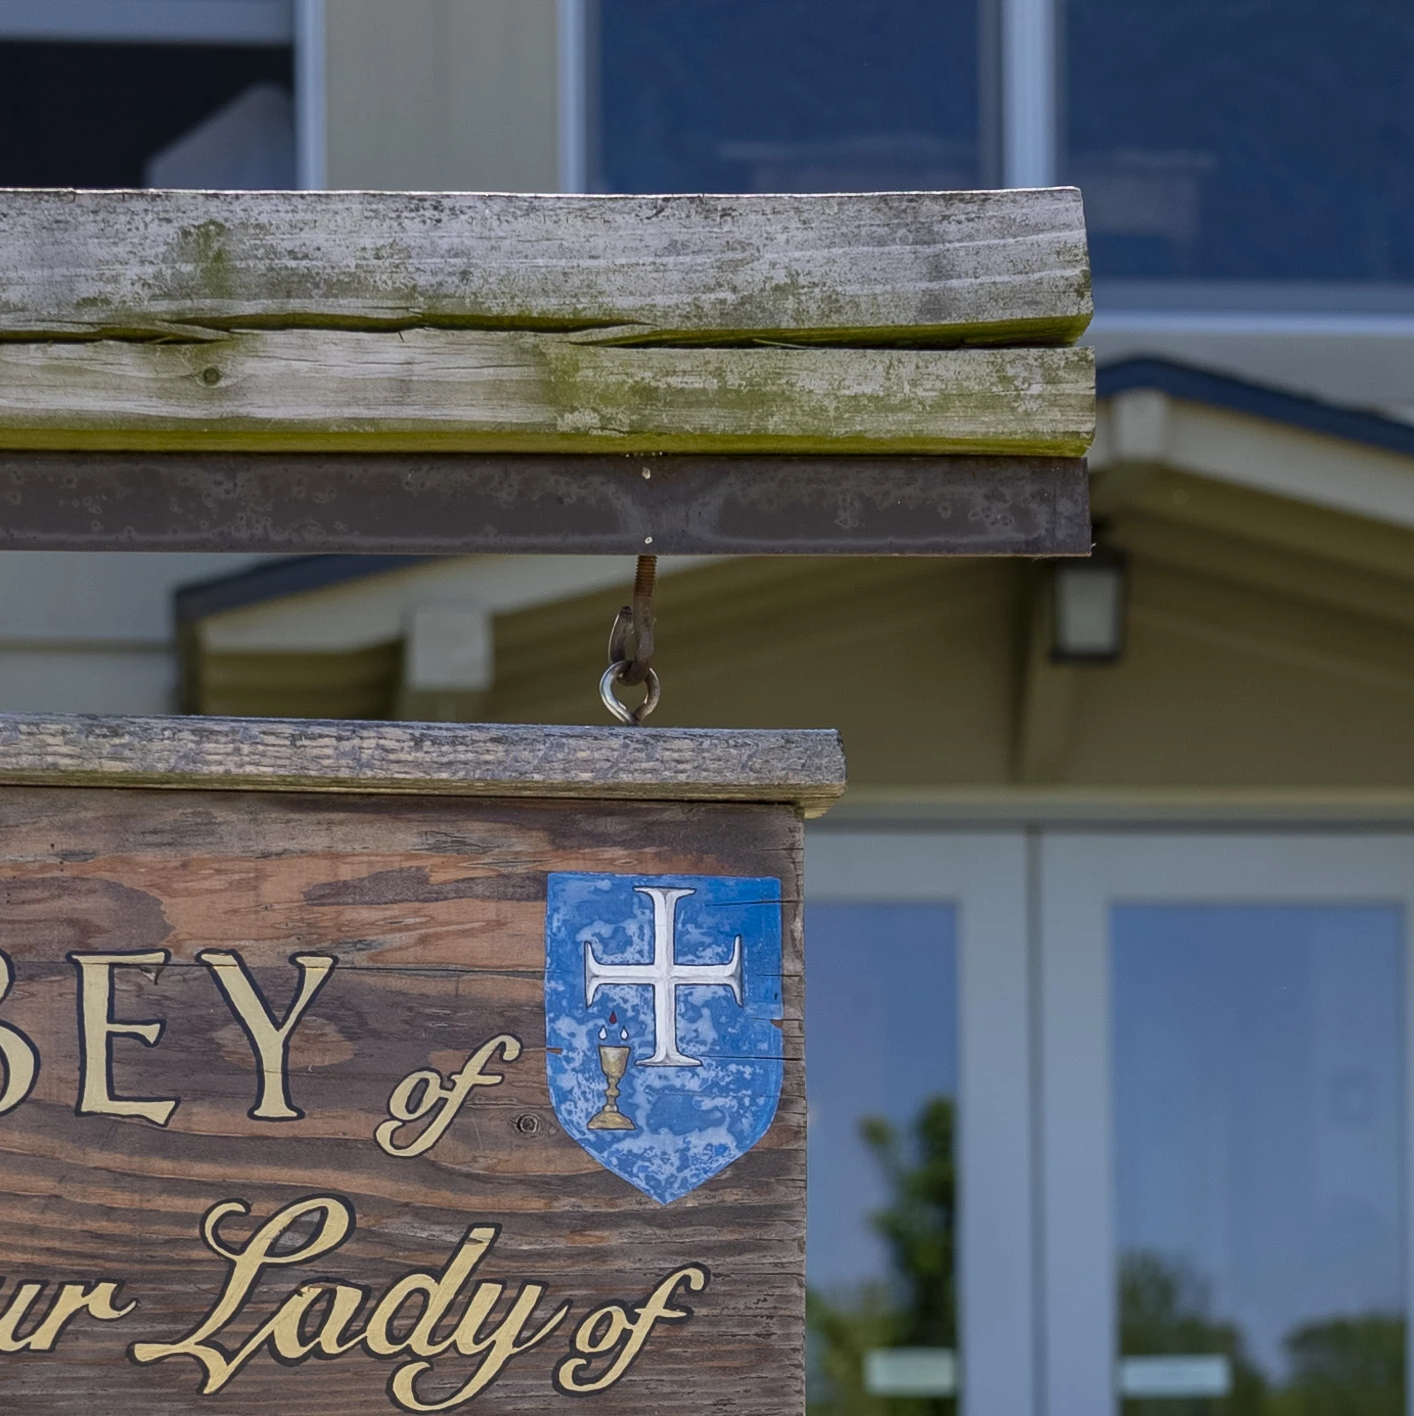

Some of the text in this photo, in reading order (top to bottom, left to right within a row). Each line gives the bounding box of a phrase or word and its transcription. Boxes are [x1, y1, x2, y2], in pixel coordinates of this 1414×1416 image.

[374, 1034, 521, 1157] of
[129, 1196, 567, 1412] Lady
[554, 1265, 709, 1394] of
